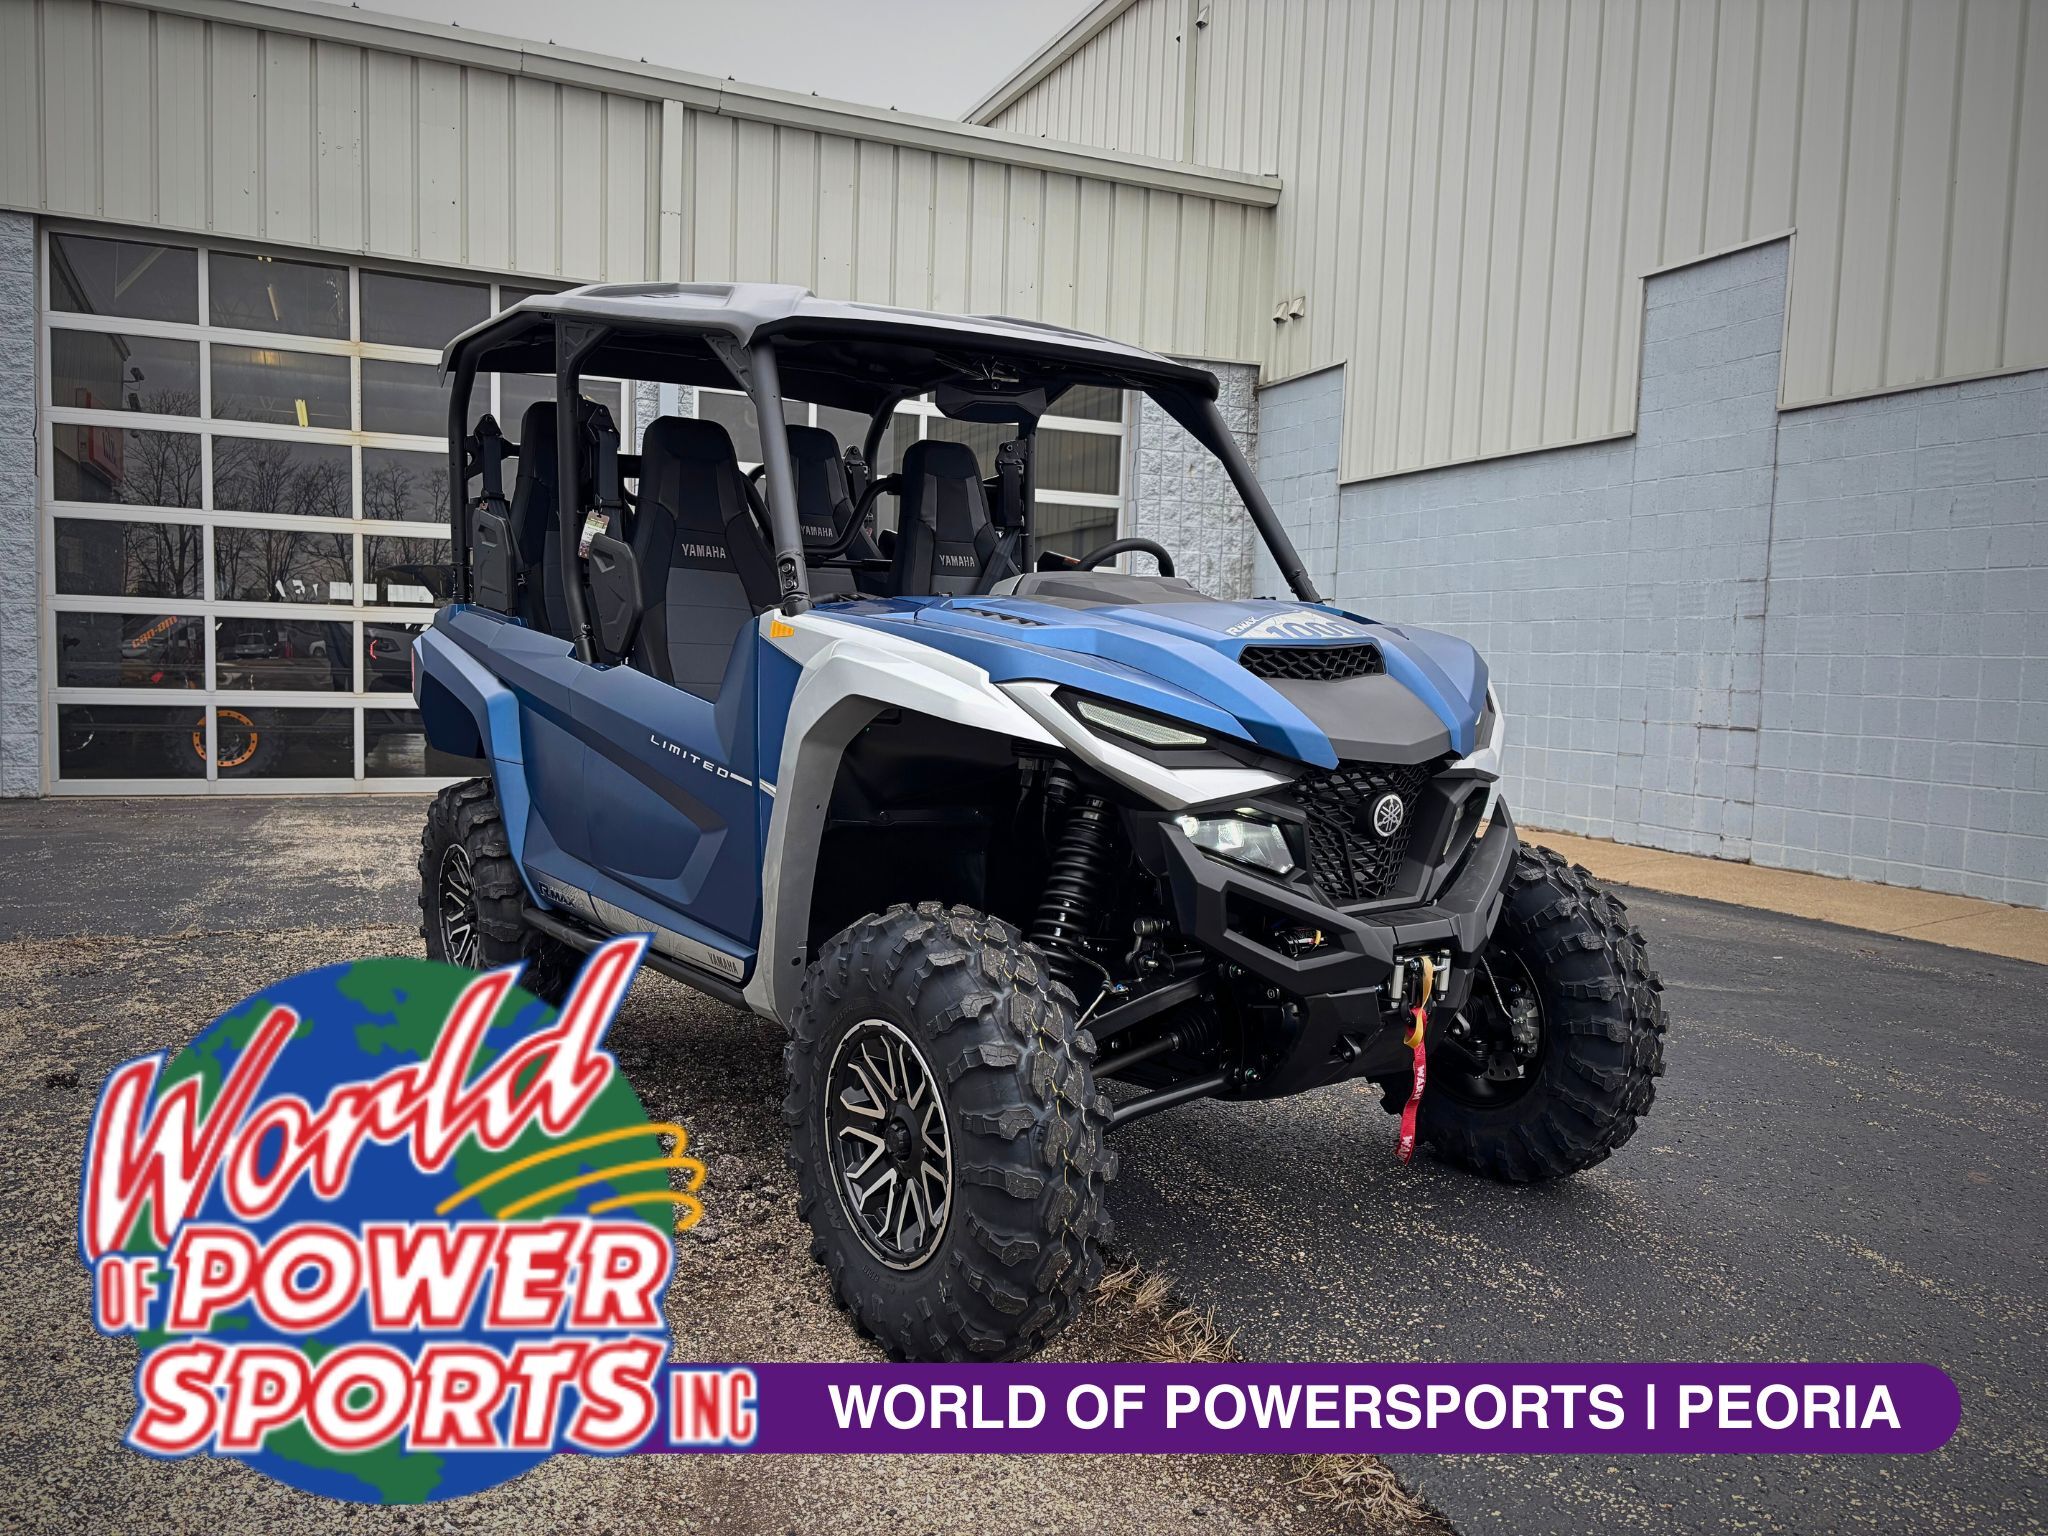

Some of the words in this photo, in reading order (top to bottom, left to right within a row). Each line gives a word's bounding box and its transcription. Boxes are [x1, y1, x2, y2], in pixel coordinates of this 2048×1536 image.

[801, 525, 833, 538] YAMAHA
[681, 543, 727, 559] YAMAHA
[939, 554, 976, 568] YAMAHA
[650, 734, 729, 779] LIMITED
[707, 951, 739, 974] YAMAHA
